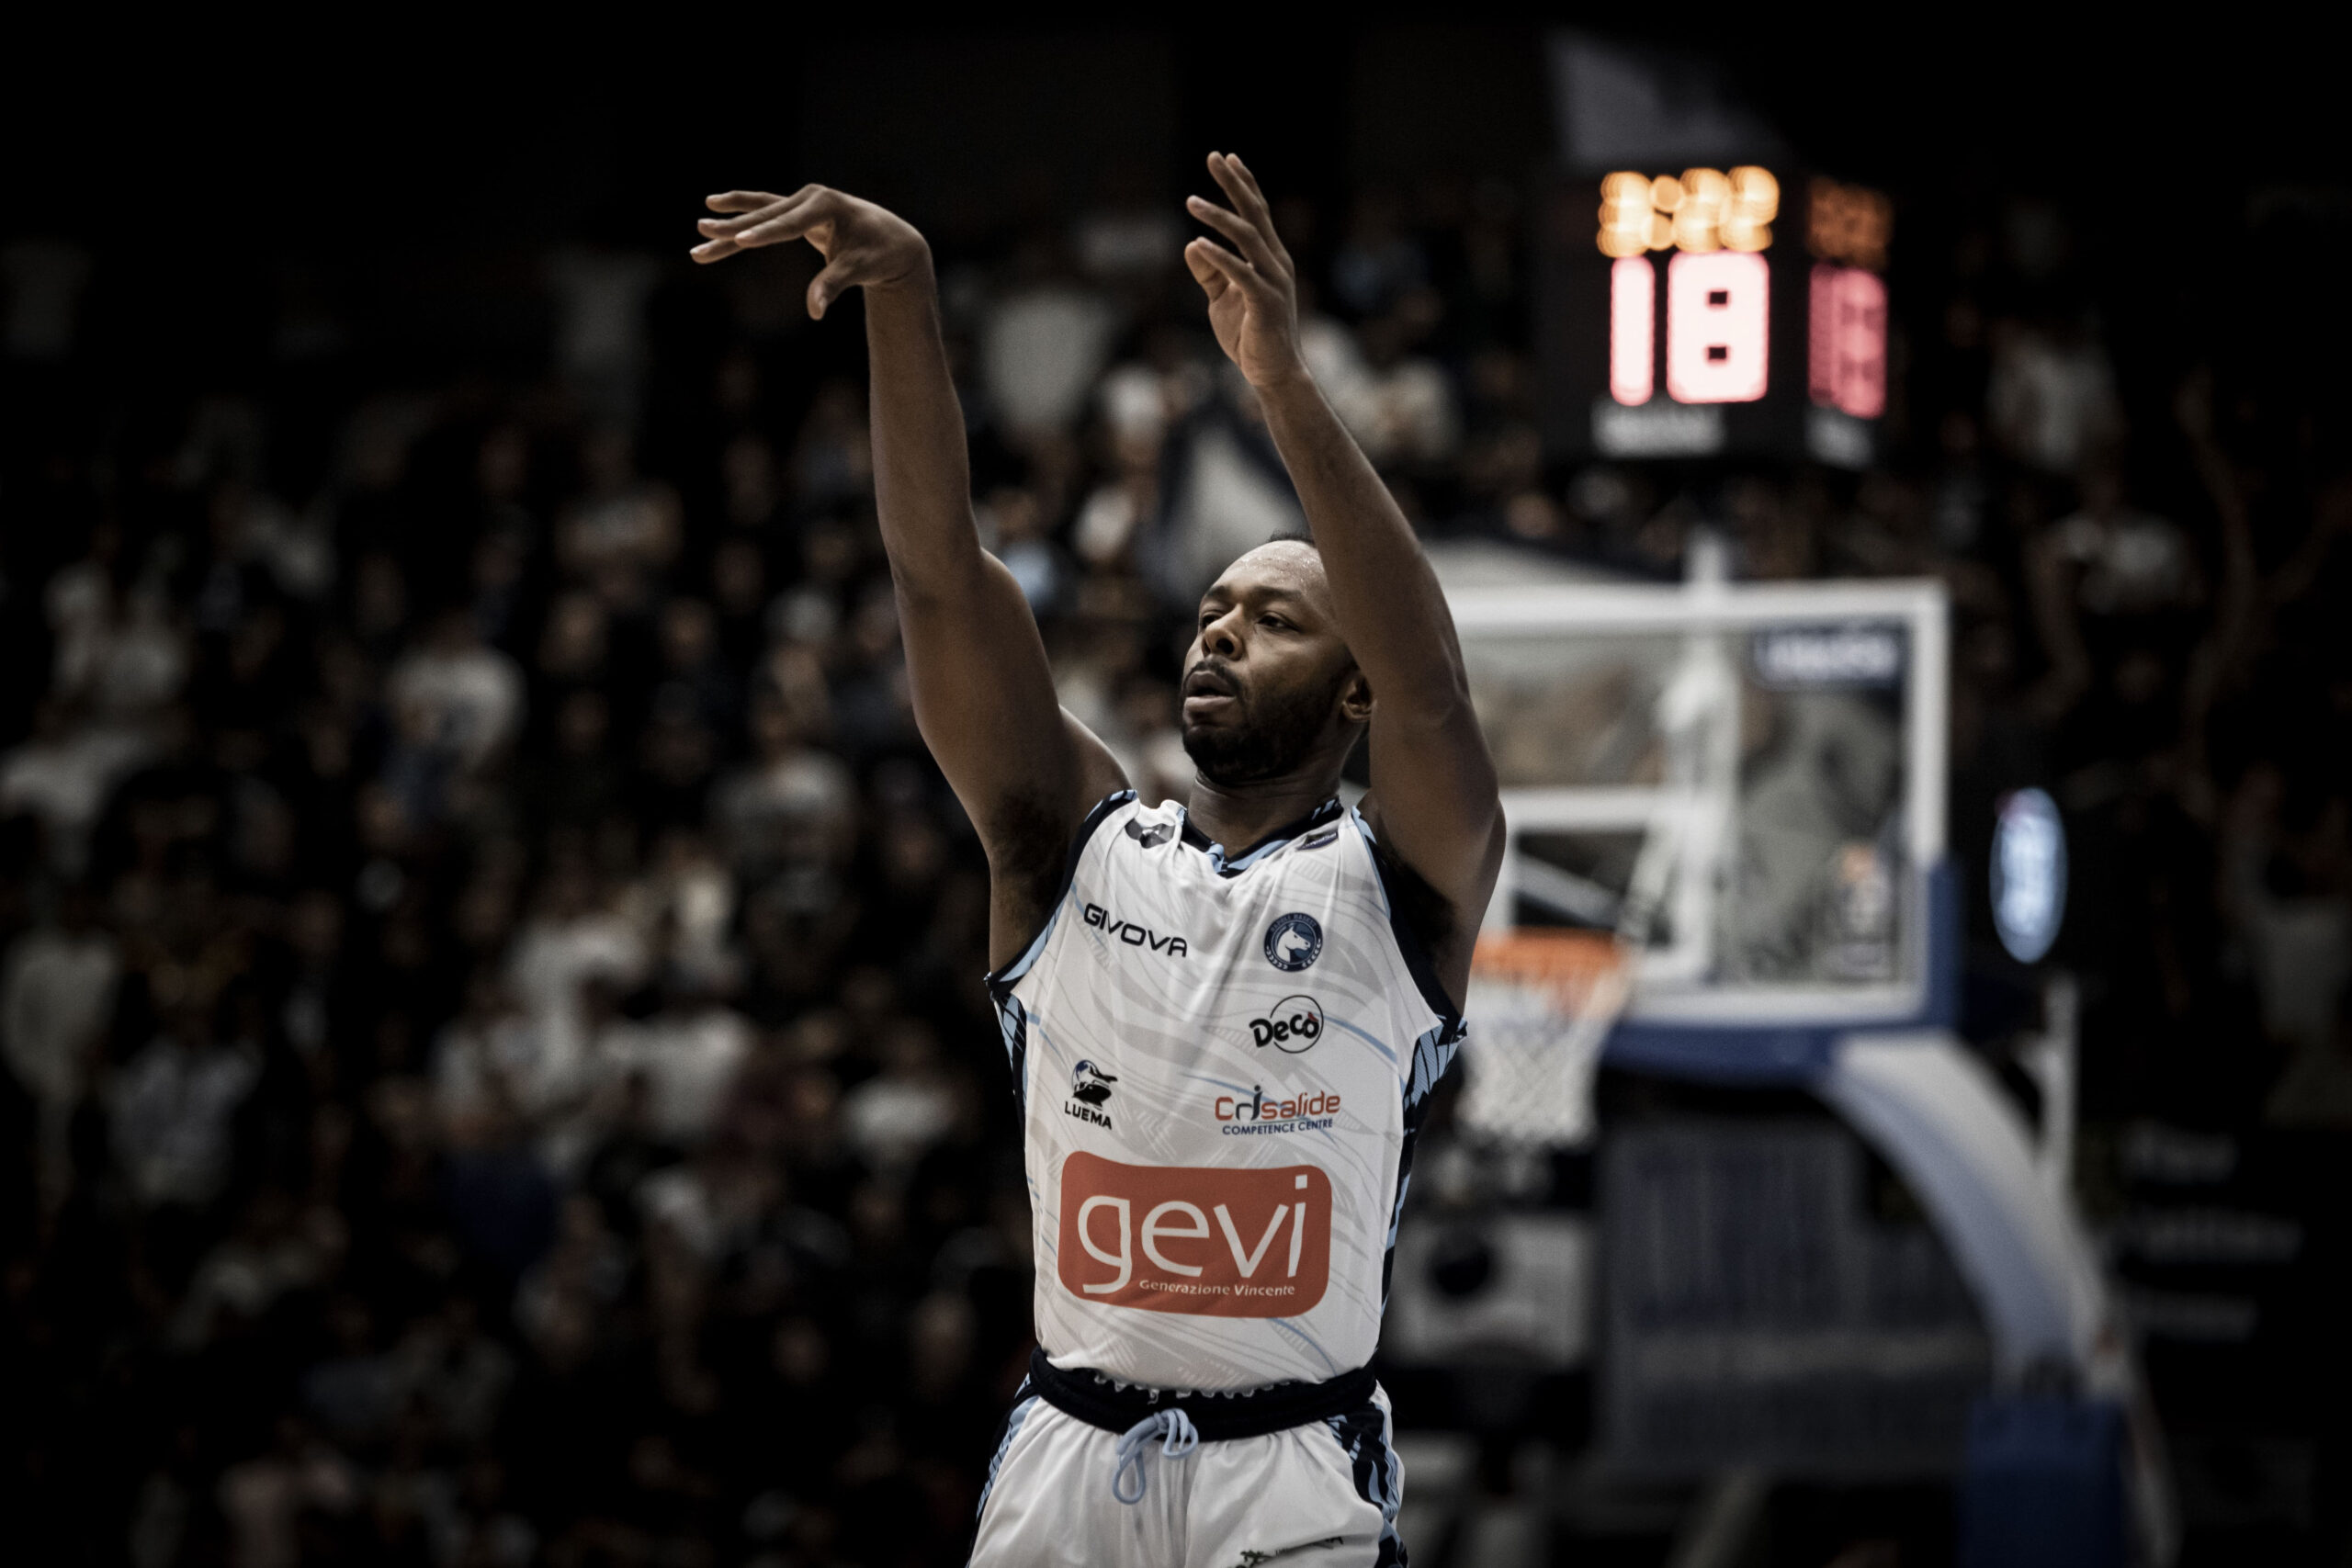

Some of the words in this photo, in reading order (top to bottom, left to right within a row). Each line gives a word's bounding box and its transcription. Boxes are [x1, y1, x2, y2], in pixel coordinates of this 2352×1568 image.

[1611, 251, 1769, 405] 18
[1083, 902, 1187, 957] GIVOVA
[1064, 1100, 1112, 1130] LUEMA
[1215, 1085, 1340, 1121] Crisalide
[1222, 1122, 1295, 1135] COMPETENCE
[1297, 1118, 1333, 1131] CENTRE
[1078, 1174, 1307, 1294] gevi
[1139, 1280, 1230, 1295] Generazione
[1233, 1283, 1295, 1296] Vincente
